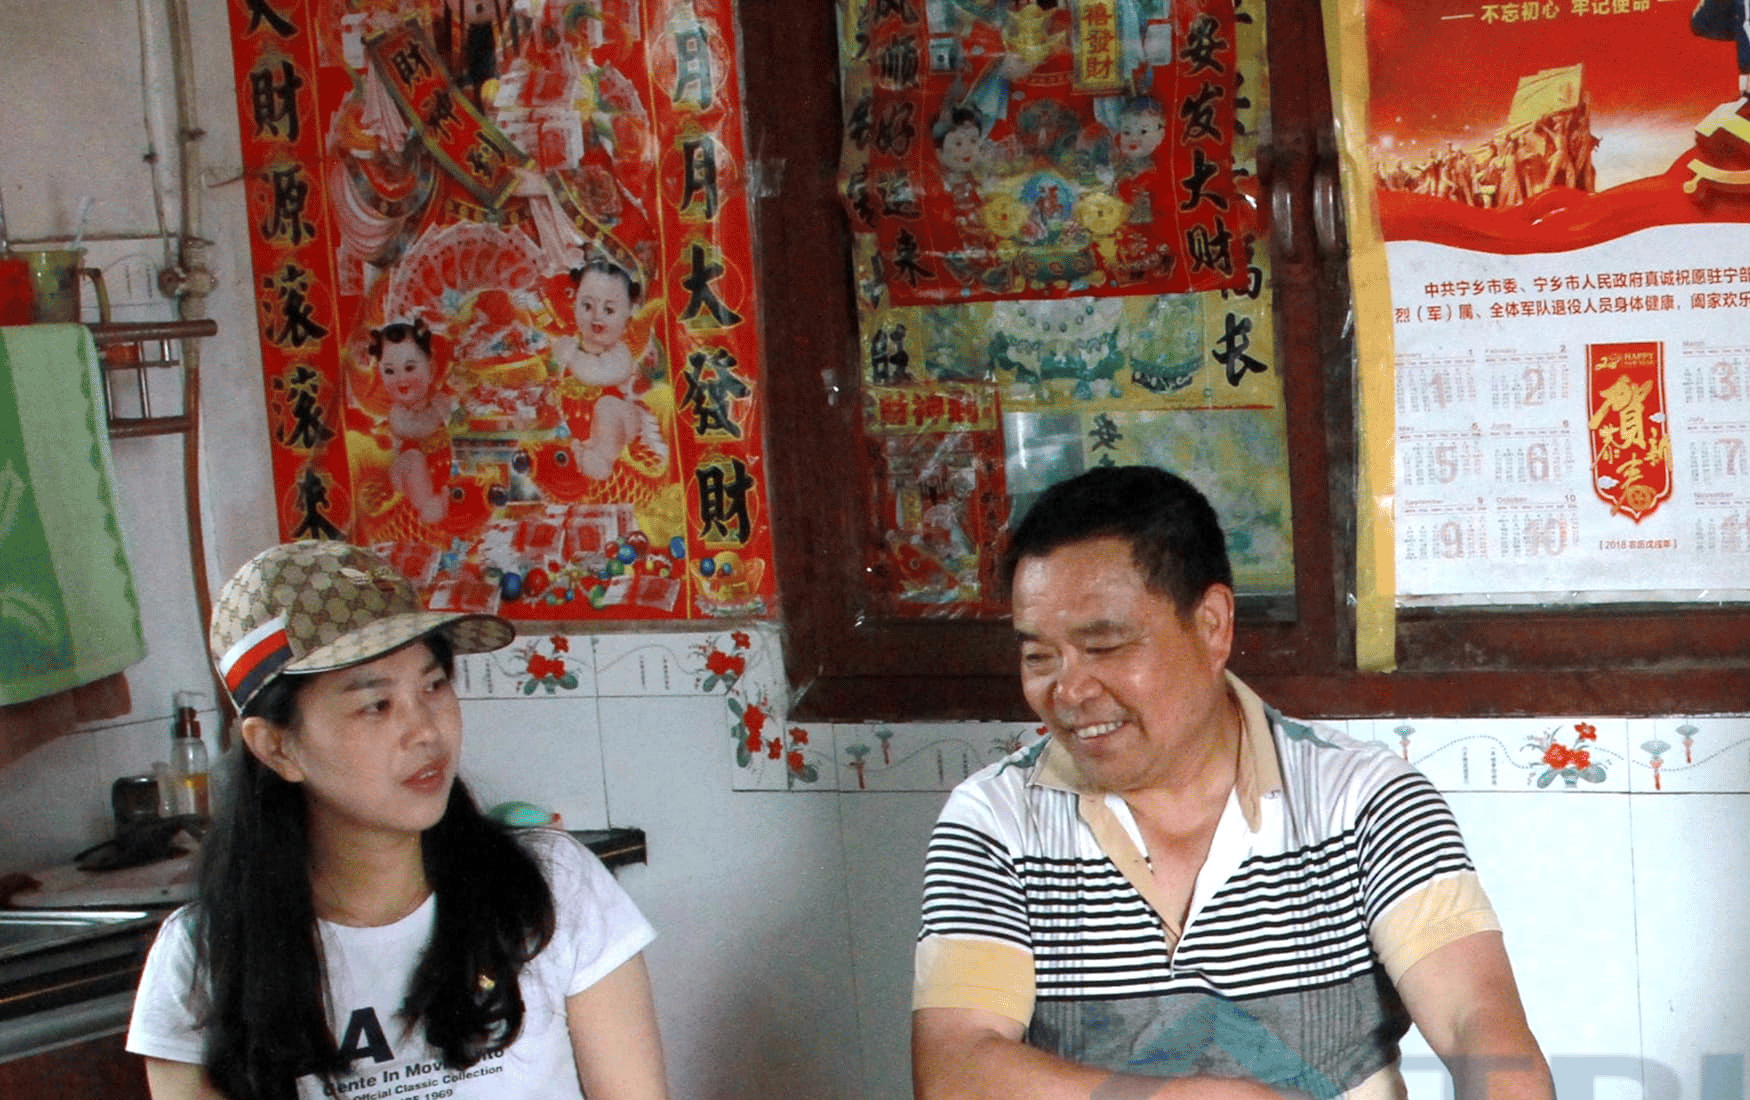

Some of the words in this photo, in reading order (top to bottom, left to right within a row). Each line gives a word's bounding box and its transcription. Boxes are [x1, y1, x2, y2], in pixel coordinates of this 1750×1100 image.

[1480, 4, 1561, 24] 不忘初心
[382, 1069, 401, 1084] In
[394, 1077, 439, 1095] Classic
[441, 1063, 503, 1085] Collection
